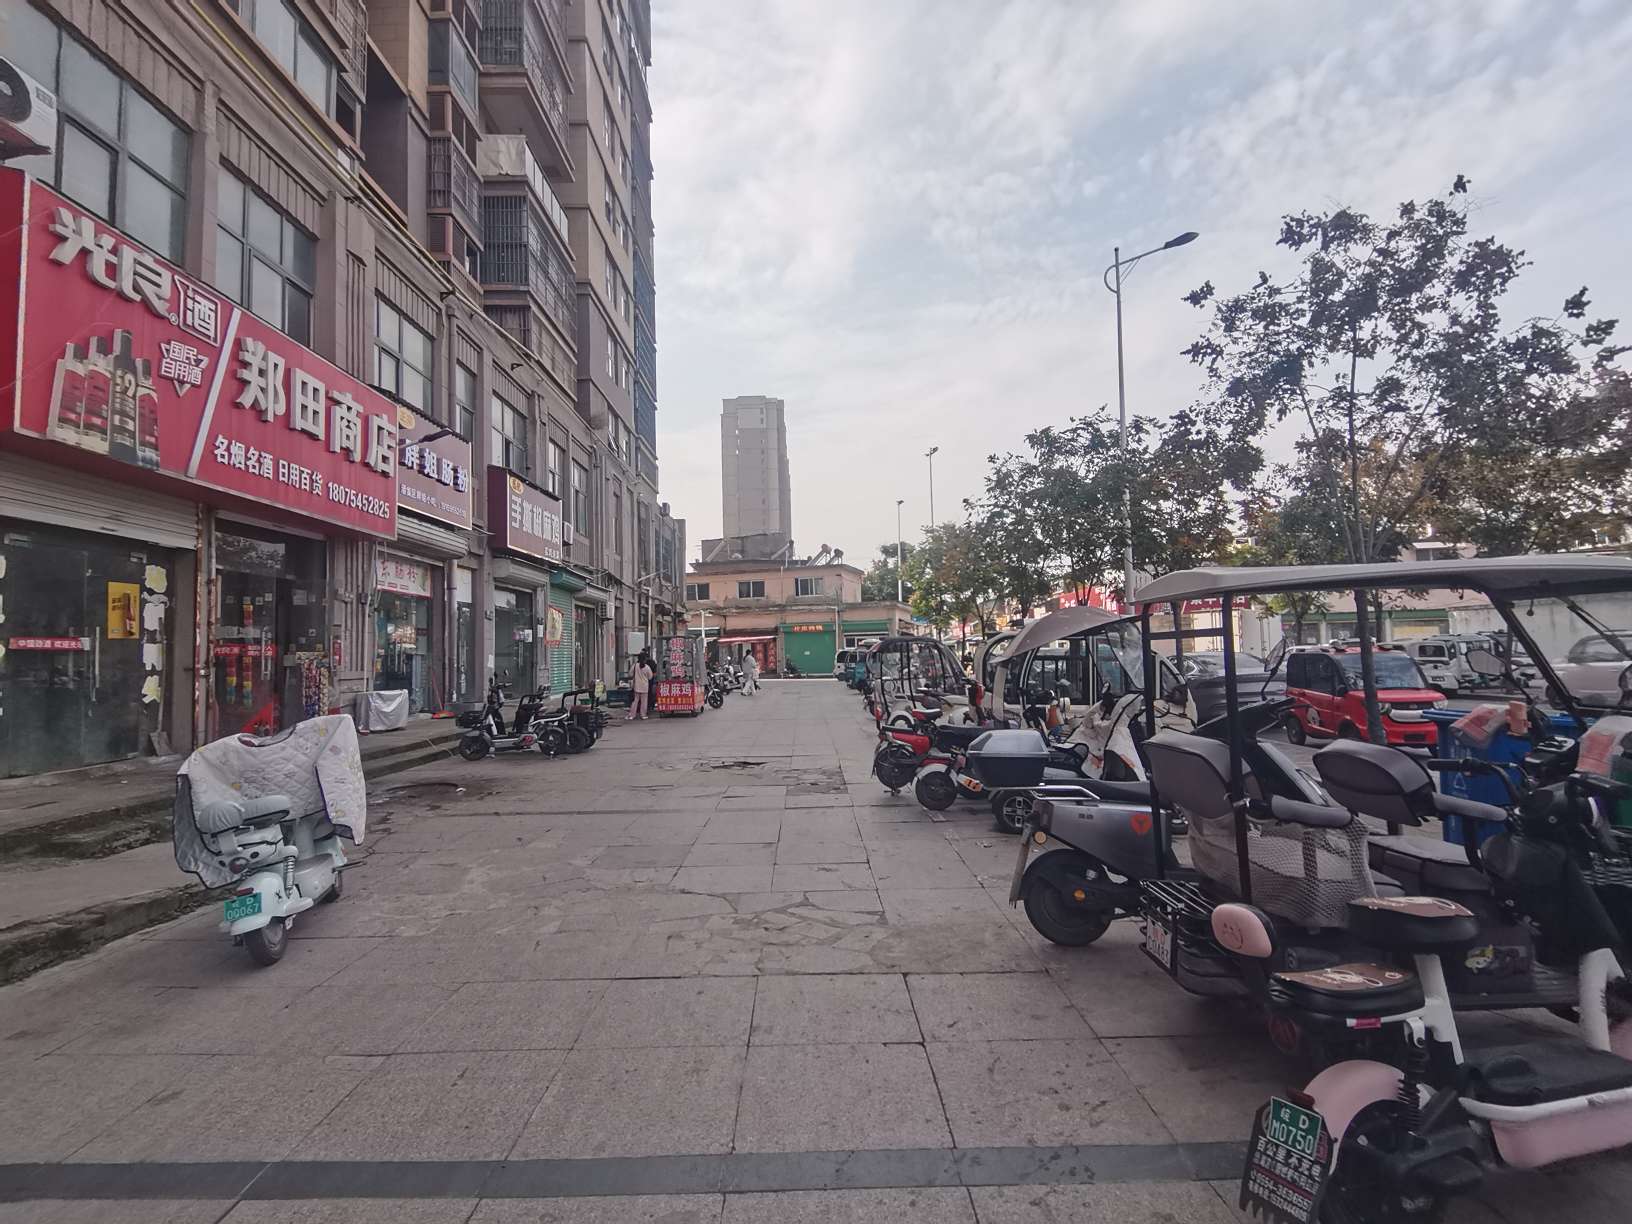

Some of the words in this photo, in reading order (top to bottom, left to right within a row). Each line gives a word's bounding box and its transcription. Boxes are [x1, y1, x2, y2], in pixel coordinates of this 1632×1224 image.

[169, 341, 197, 366] 国民
[161, 358, 202, 386] 自用酒
[236, 337, 397, 478] 郑田商店
[214, 435, 273, 480] 名烟名酒
[278, 459, 323, 496] 日用百货
[328, 482, 390, 519] 18075452825
[660, 683, 692, 697] 椒麻鸡
[1299, 1115, 1309, 1129] D
[1270, 1119, 1314, 1155] M0750
